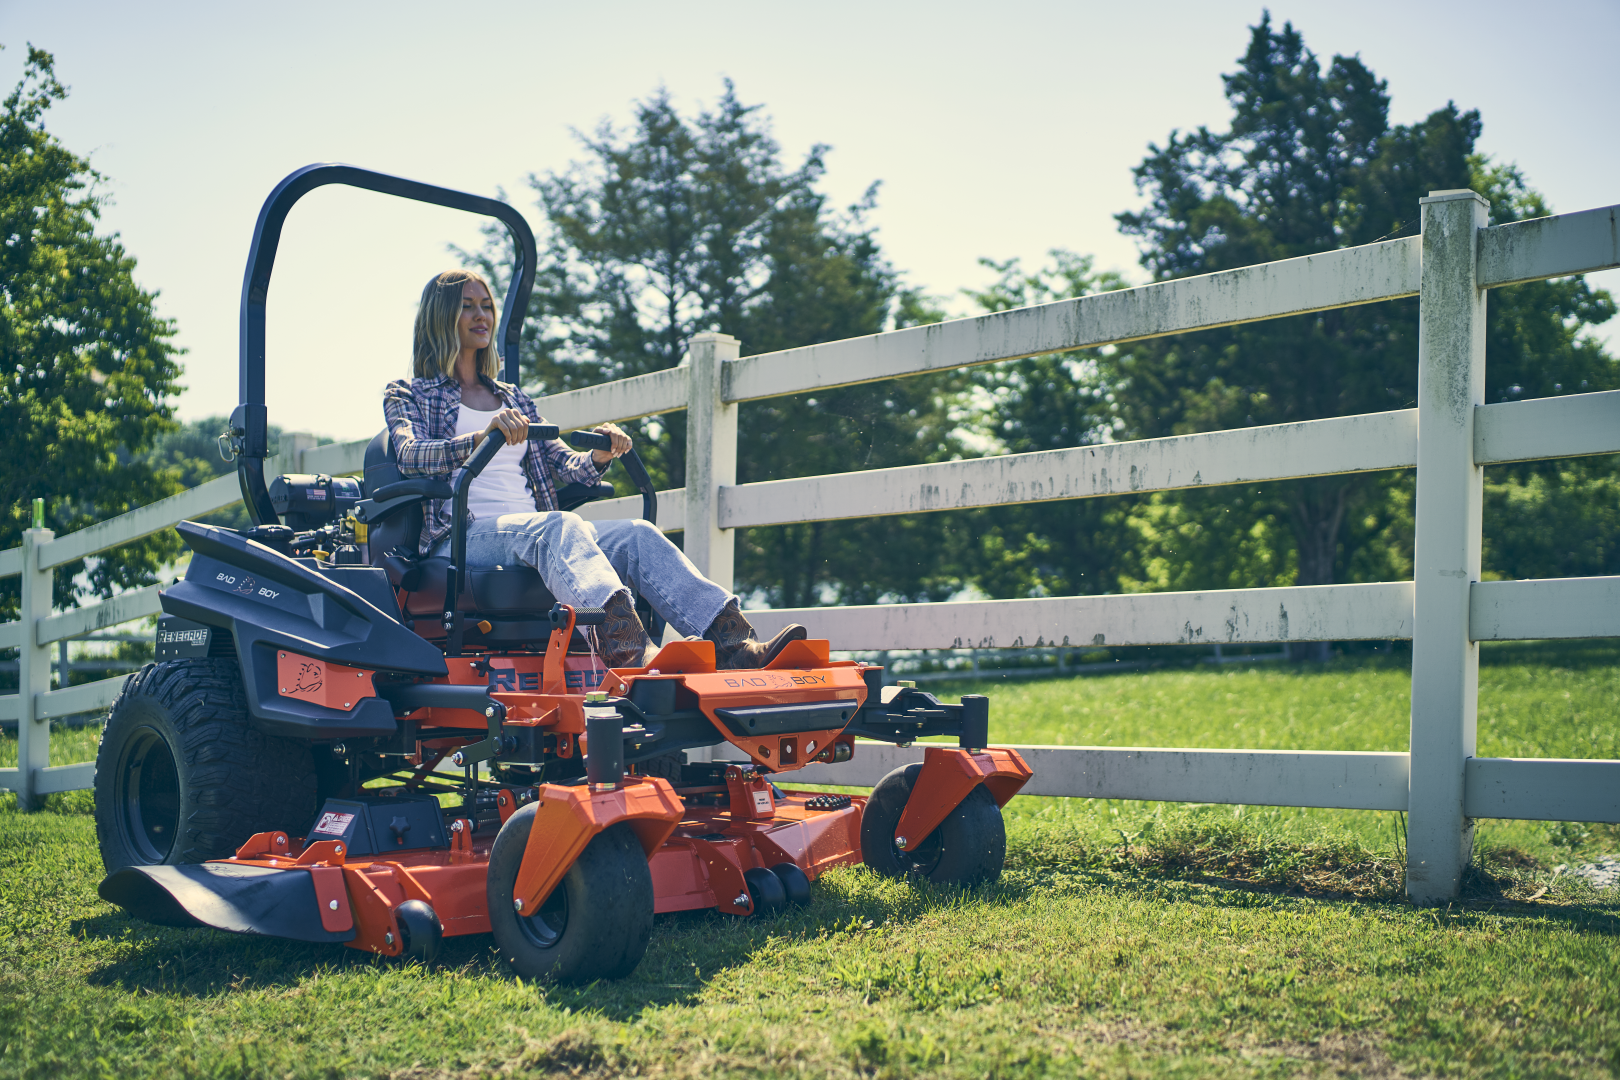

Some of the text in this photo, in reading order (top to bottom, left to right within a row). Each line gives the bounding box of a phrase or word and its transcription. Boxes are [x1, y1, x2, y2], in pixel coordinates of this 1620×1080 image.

[216, 572, 280, 599] BAD BOY
[158, 629, 208, 643] RENEGADE
[724, 675, 826, 688] BAD BOY
